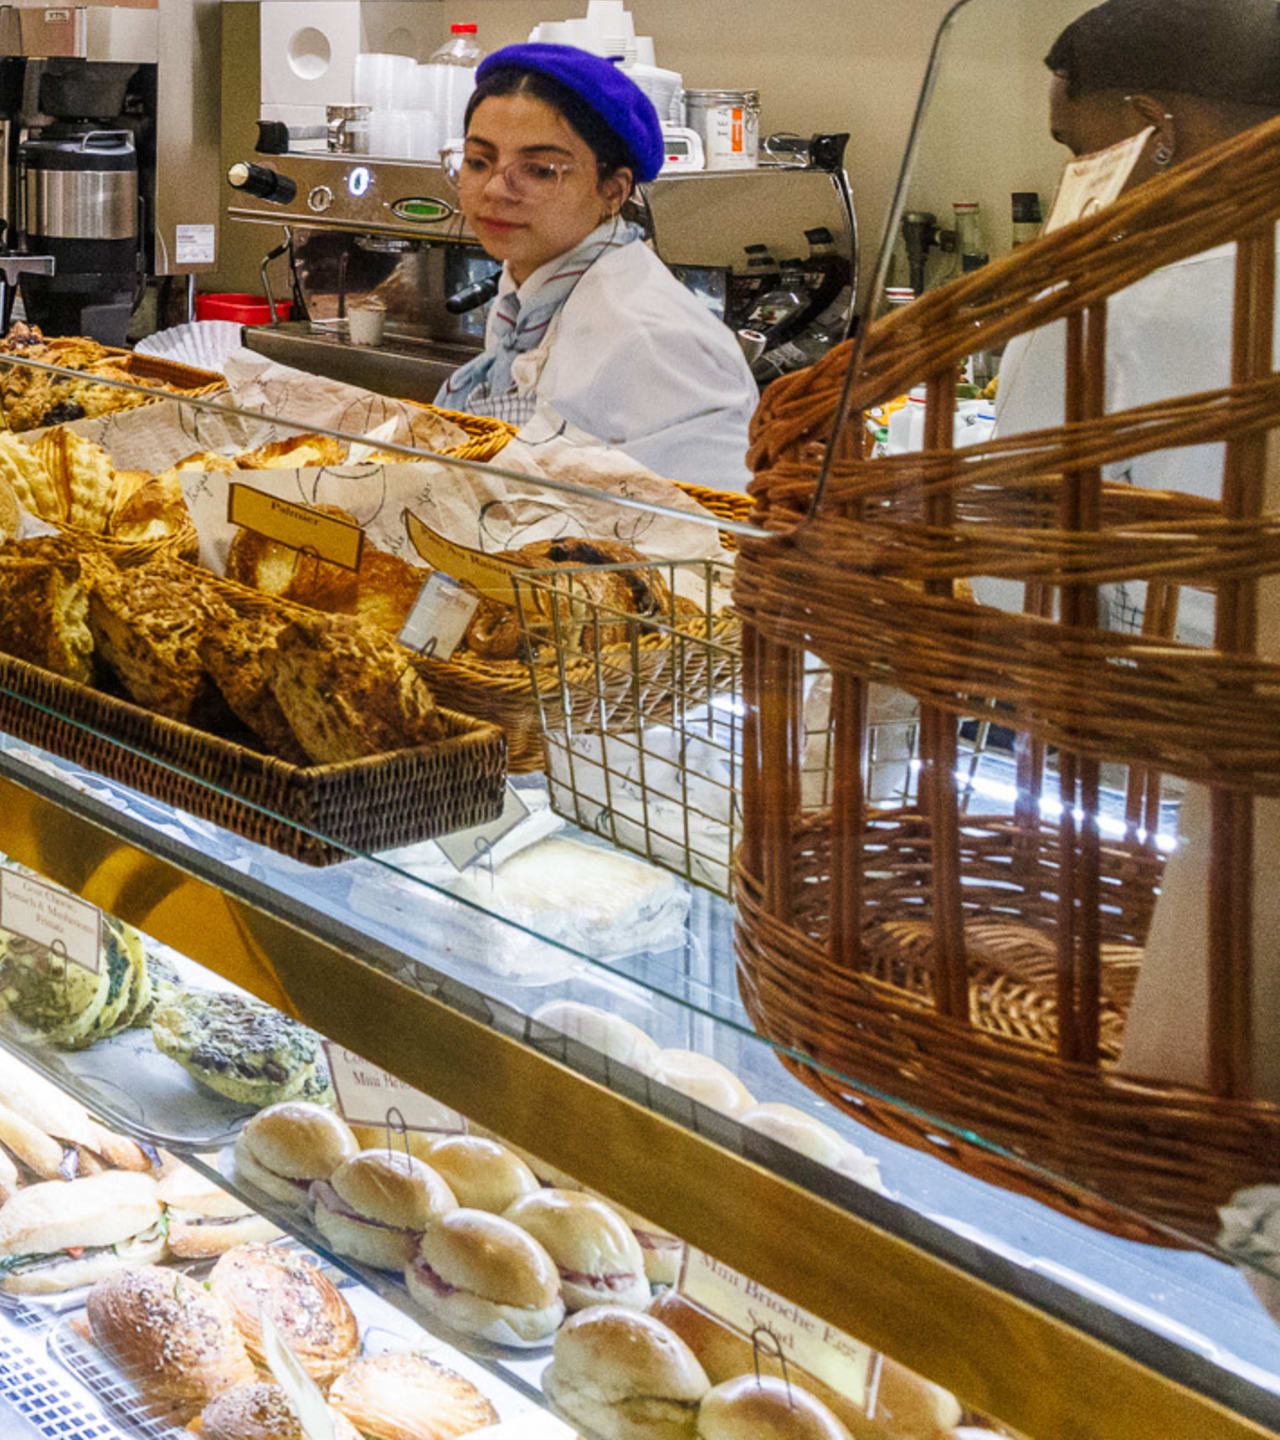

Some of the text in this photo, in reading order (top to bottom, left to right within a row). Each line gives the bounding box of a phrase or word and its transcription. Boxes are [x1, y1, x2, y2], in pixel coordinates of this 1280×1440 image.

[271, 501, 319, 527] Palmier
[352, 1069, 381, 1088] Mini
[701, 1254, 740, 1288] Mini
[744, 1277, 817, 1336] Brioche
[746, 1307, 795, 1352] Salad
